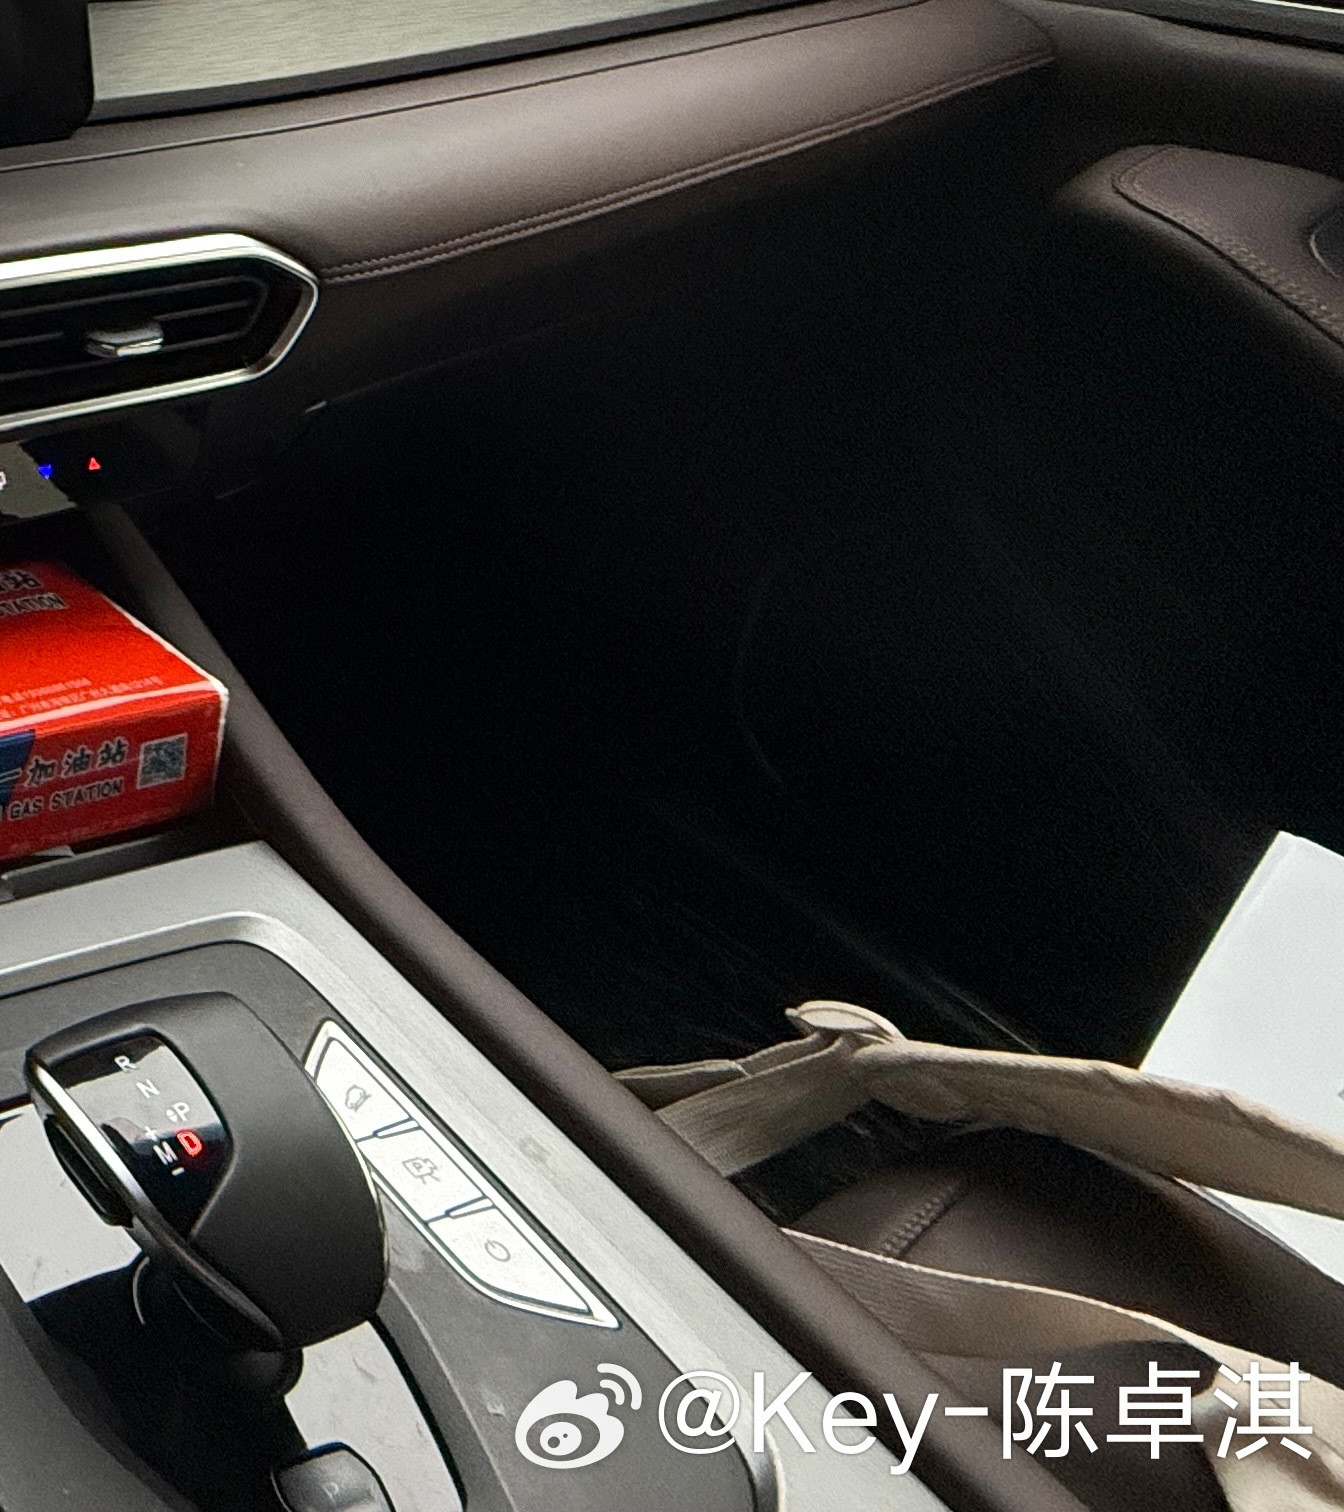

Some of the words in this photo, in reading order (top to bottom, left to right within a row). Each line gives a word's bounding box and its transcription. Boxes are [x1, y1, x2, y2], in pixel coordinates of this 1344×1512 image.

[8, 796, 44, 821] GAS
[50, 776, 124, 810] STATION
[114, 1055, 137, 1073] R
[136, 1079, 160, 1099] N
[173, 1102, 190, 1122] P
[153, 1140, 179, 1166] M
[176, 1130, 203, 1157] D
